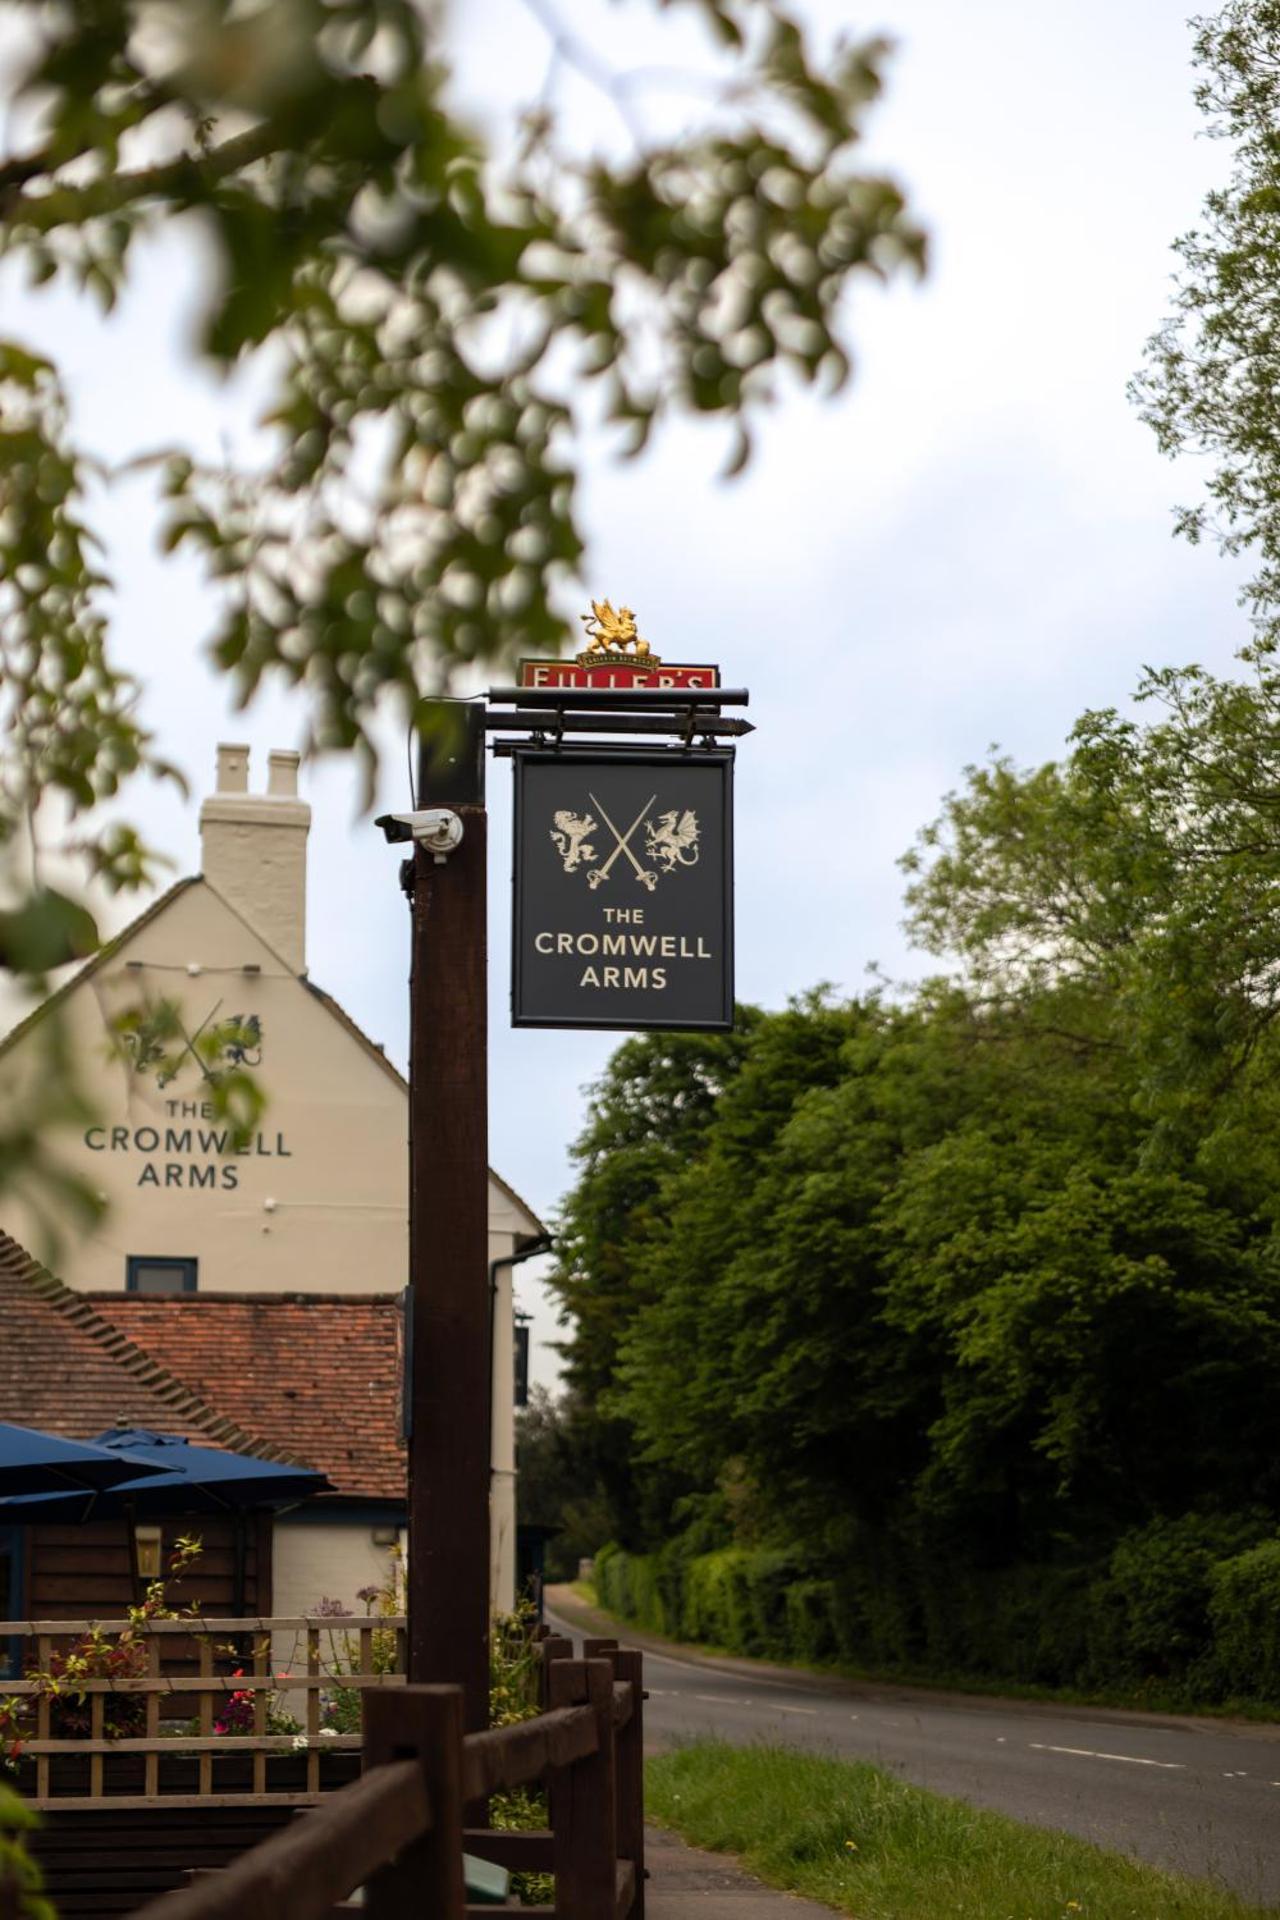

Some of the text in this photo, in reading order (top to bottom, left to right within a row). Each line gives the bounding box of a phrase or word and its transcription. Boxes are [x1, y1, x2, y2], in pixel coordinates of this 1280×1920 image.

[603, 908, 645, 924] THE
[534, 932, 713, 959] CROMWELL
[579, 966, 668, 989] ARMS
[166, 1099, 214, 1120] THE
[137, 1162, 239, 1191] ARMS
